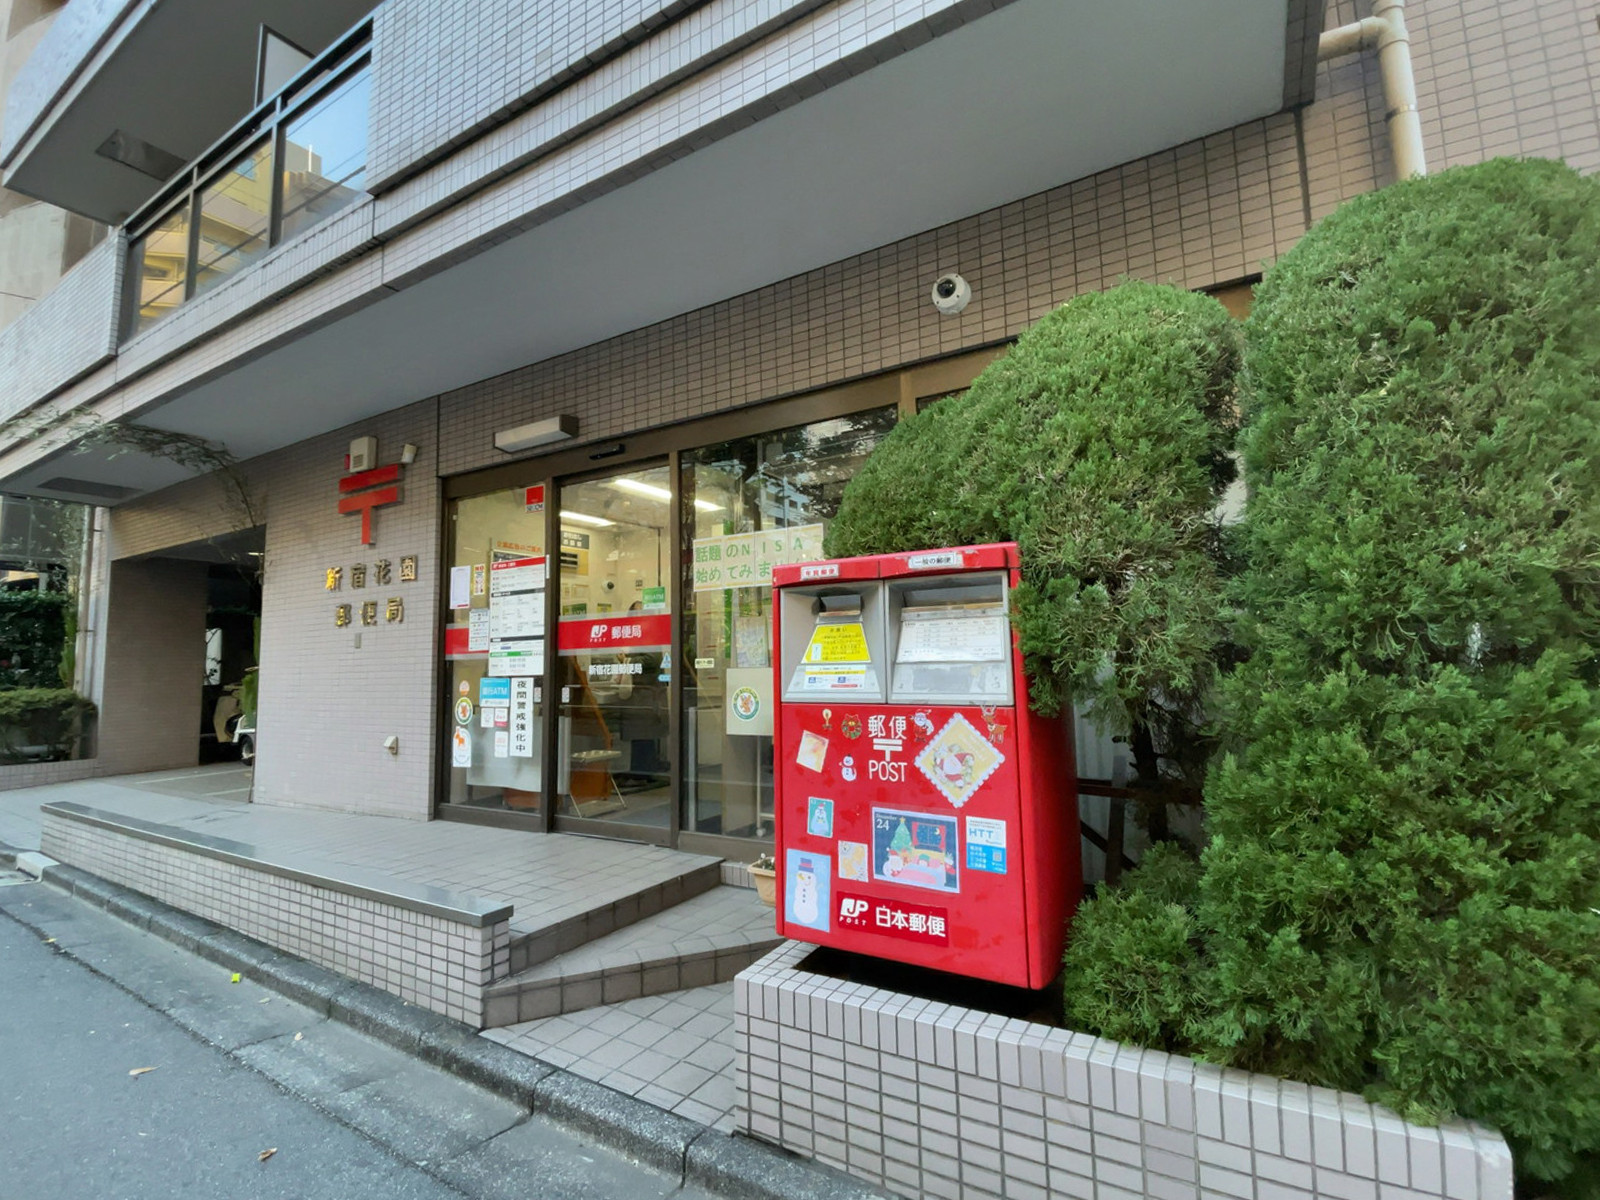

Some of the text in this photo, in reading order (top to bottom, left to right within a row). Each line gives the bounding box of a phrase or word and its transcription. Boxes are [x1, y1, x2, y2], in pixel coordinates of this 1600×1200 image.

[695, 537, 803, 563] 話題のNISA
[325, 554, 418, 592] 新宿花園
[335, 597, 404, 628] 郵便局
[611, 624, 642, 639] 郵便局
[588, 663, 643, 675] 新宿花園郵便局
[515, 680, 528, 753] 夜間警戒強化中
[868, 714, 907, 739] 郵便
[868, 759, 908, 782] POST
[876, 818, 890, 831] 24
[839, 916, 867, 926] POST
[875, 905, 946, 938] 日本郵便
